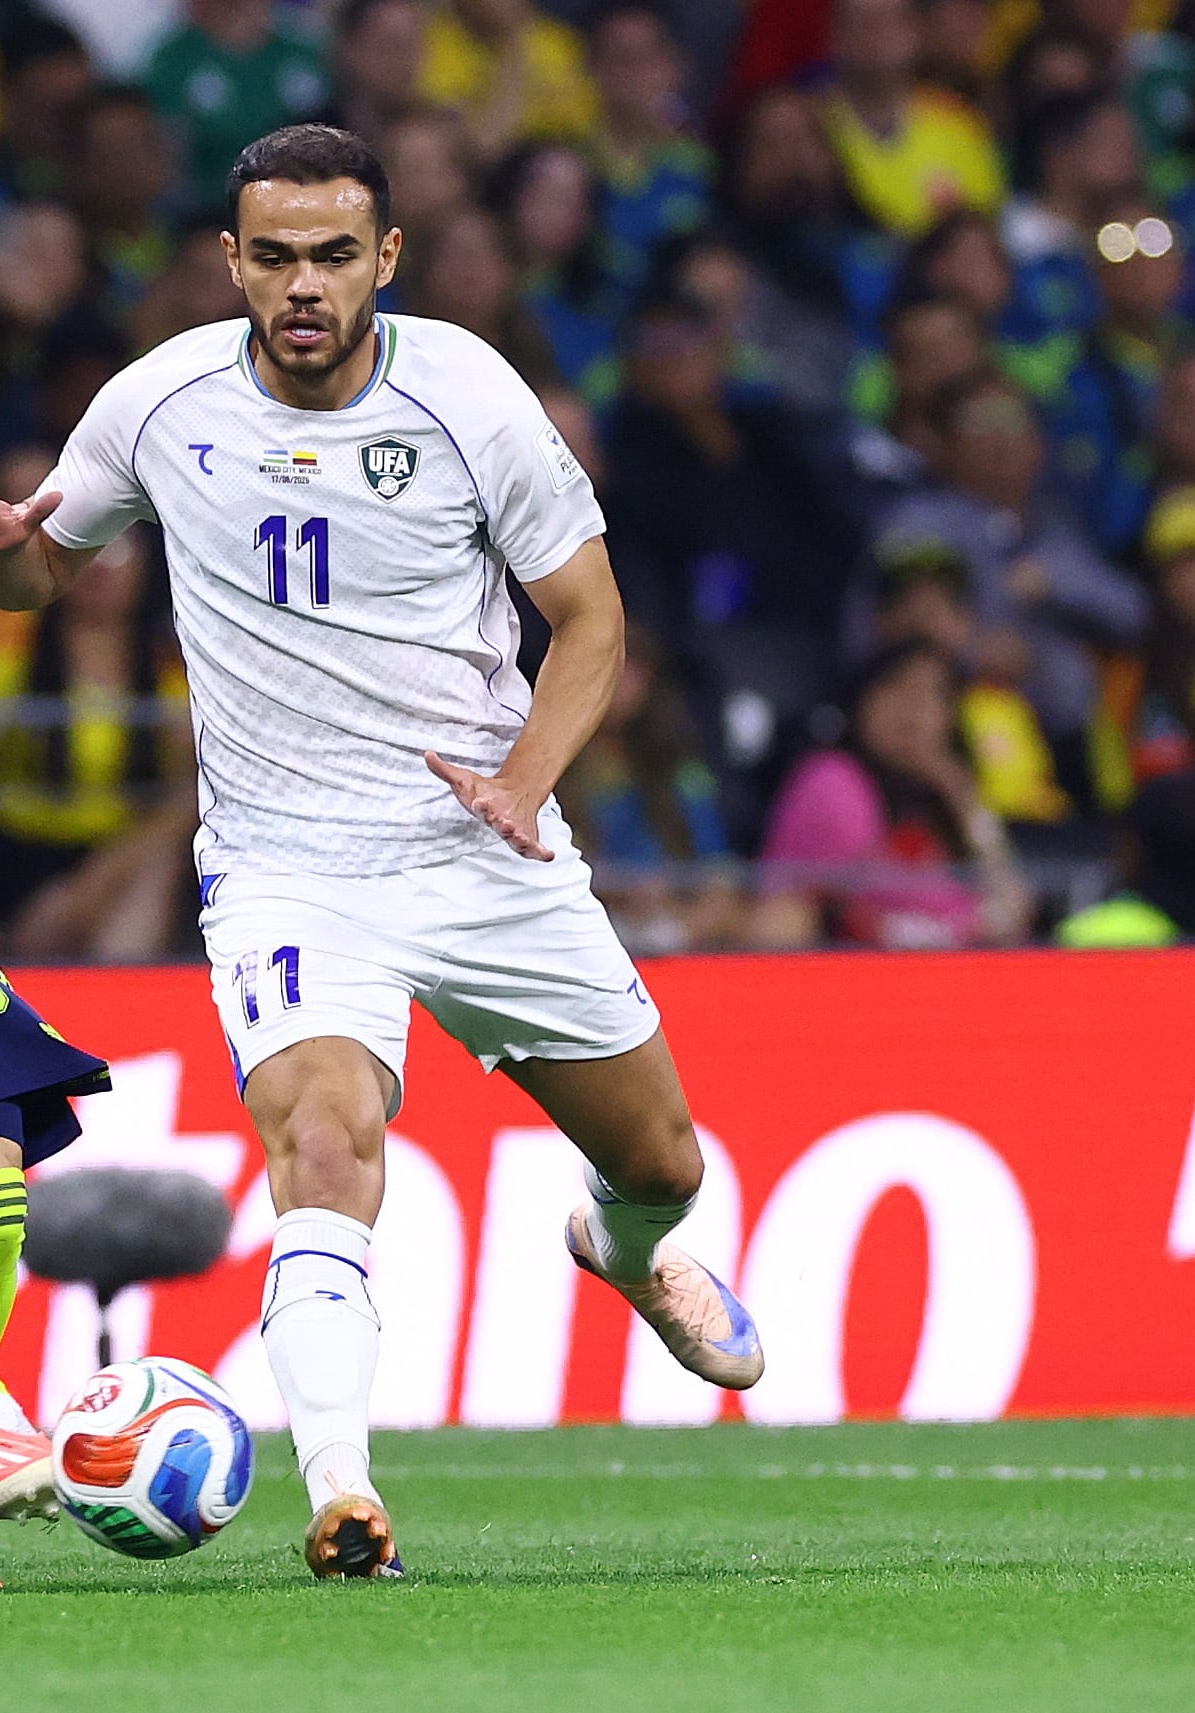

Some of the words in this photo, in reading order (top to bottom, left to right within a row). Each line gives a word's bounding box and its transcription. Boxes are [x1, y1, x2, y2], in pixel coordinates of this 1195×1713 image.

[368, 450, 411, 474] UFA
[253, 514, 331, 610] 11
[231, 945, 302, 1030] 11
